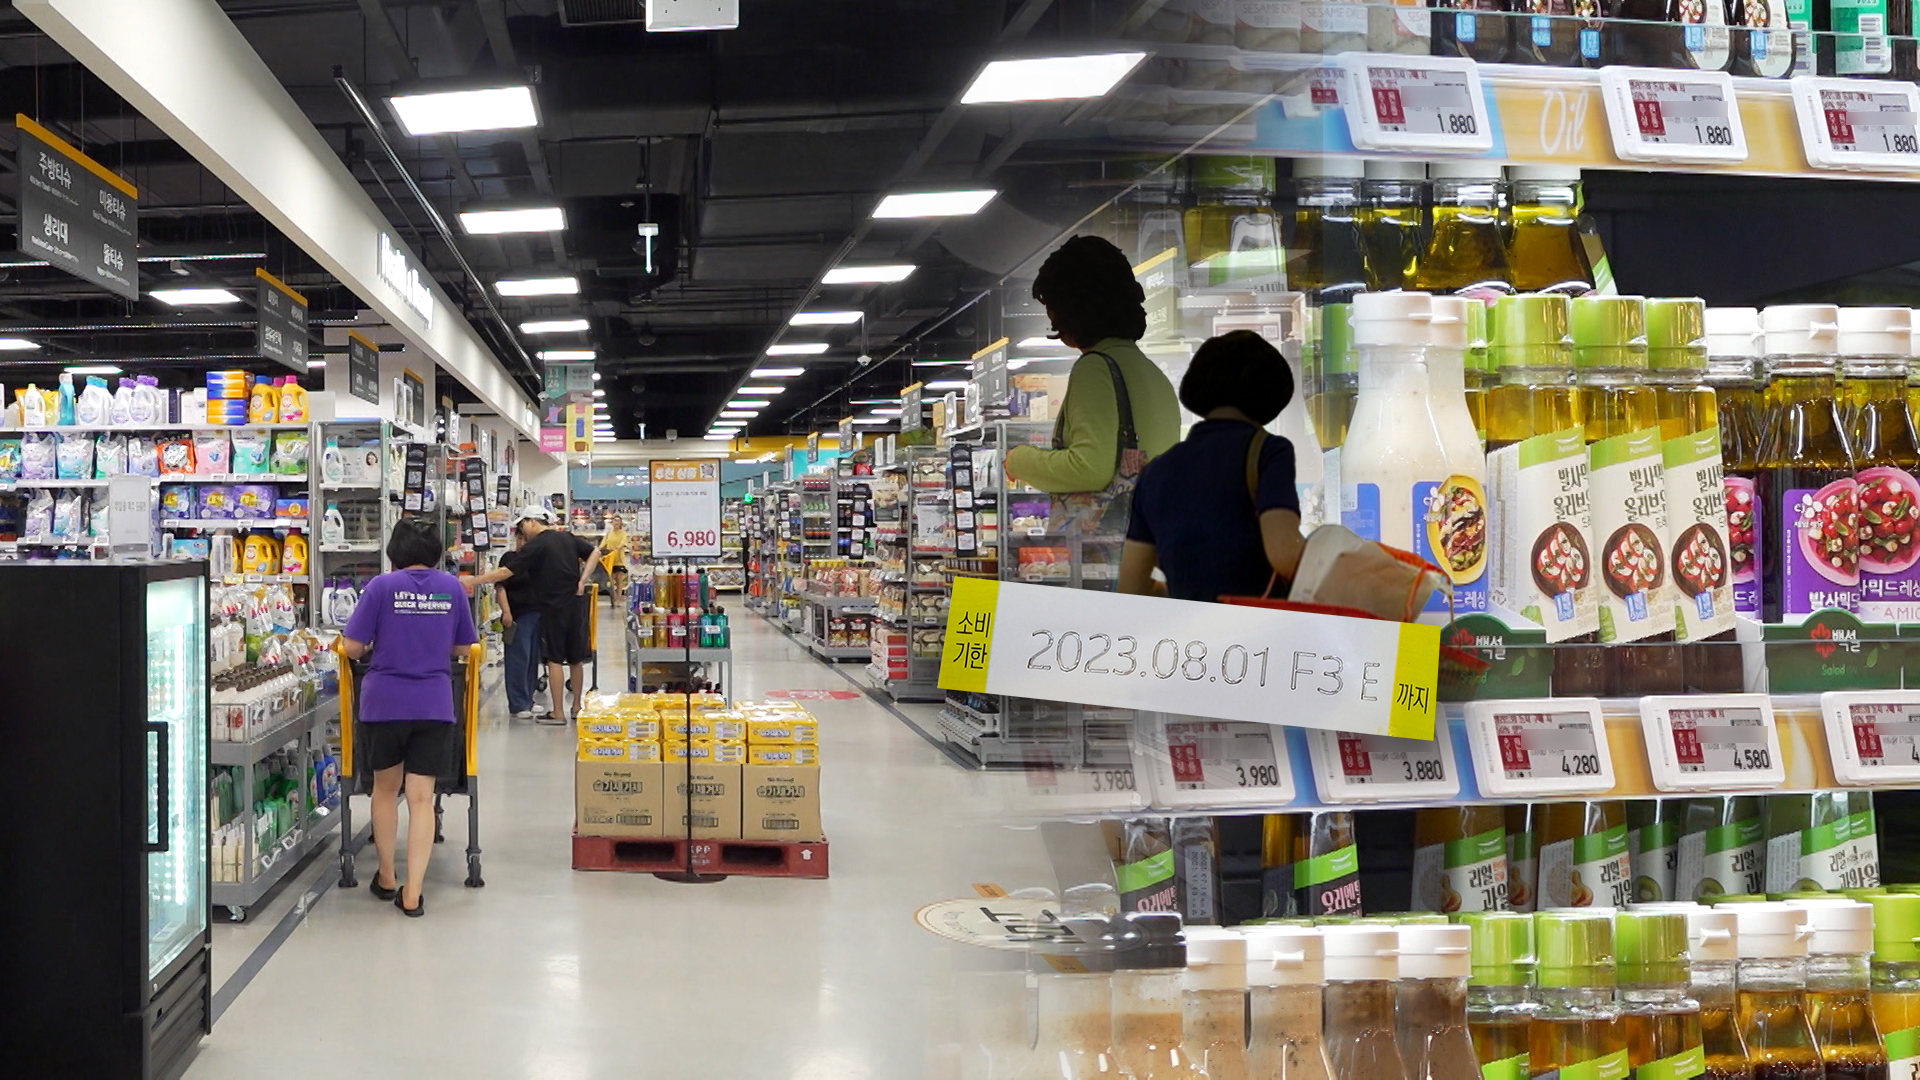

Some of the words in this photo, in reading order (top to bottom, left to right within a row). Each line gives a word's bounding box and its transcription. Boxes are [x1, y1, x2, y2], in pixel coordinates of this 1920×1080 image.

[1306, 7, 1345, 18] SESAME
[1540, 87, 1589, 155] Oil
[39, 151, 72, 190] 주방티슈
[99, 189, 127, 222] 미용티슈
[43, 213, 69, 246] 생리대
[103, 242, 124, 272] 물티슈
[667, 530, 716, 549] 6,980
[1475, 635, 1506, 660] 백설
[1832, 629, 1861, 653] 백설
[1468, 864, 1493, 888] 리얼
[1599, 859, 1620, 884] 리얼
